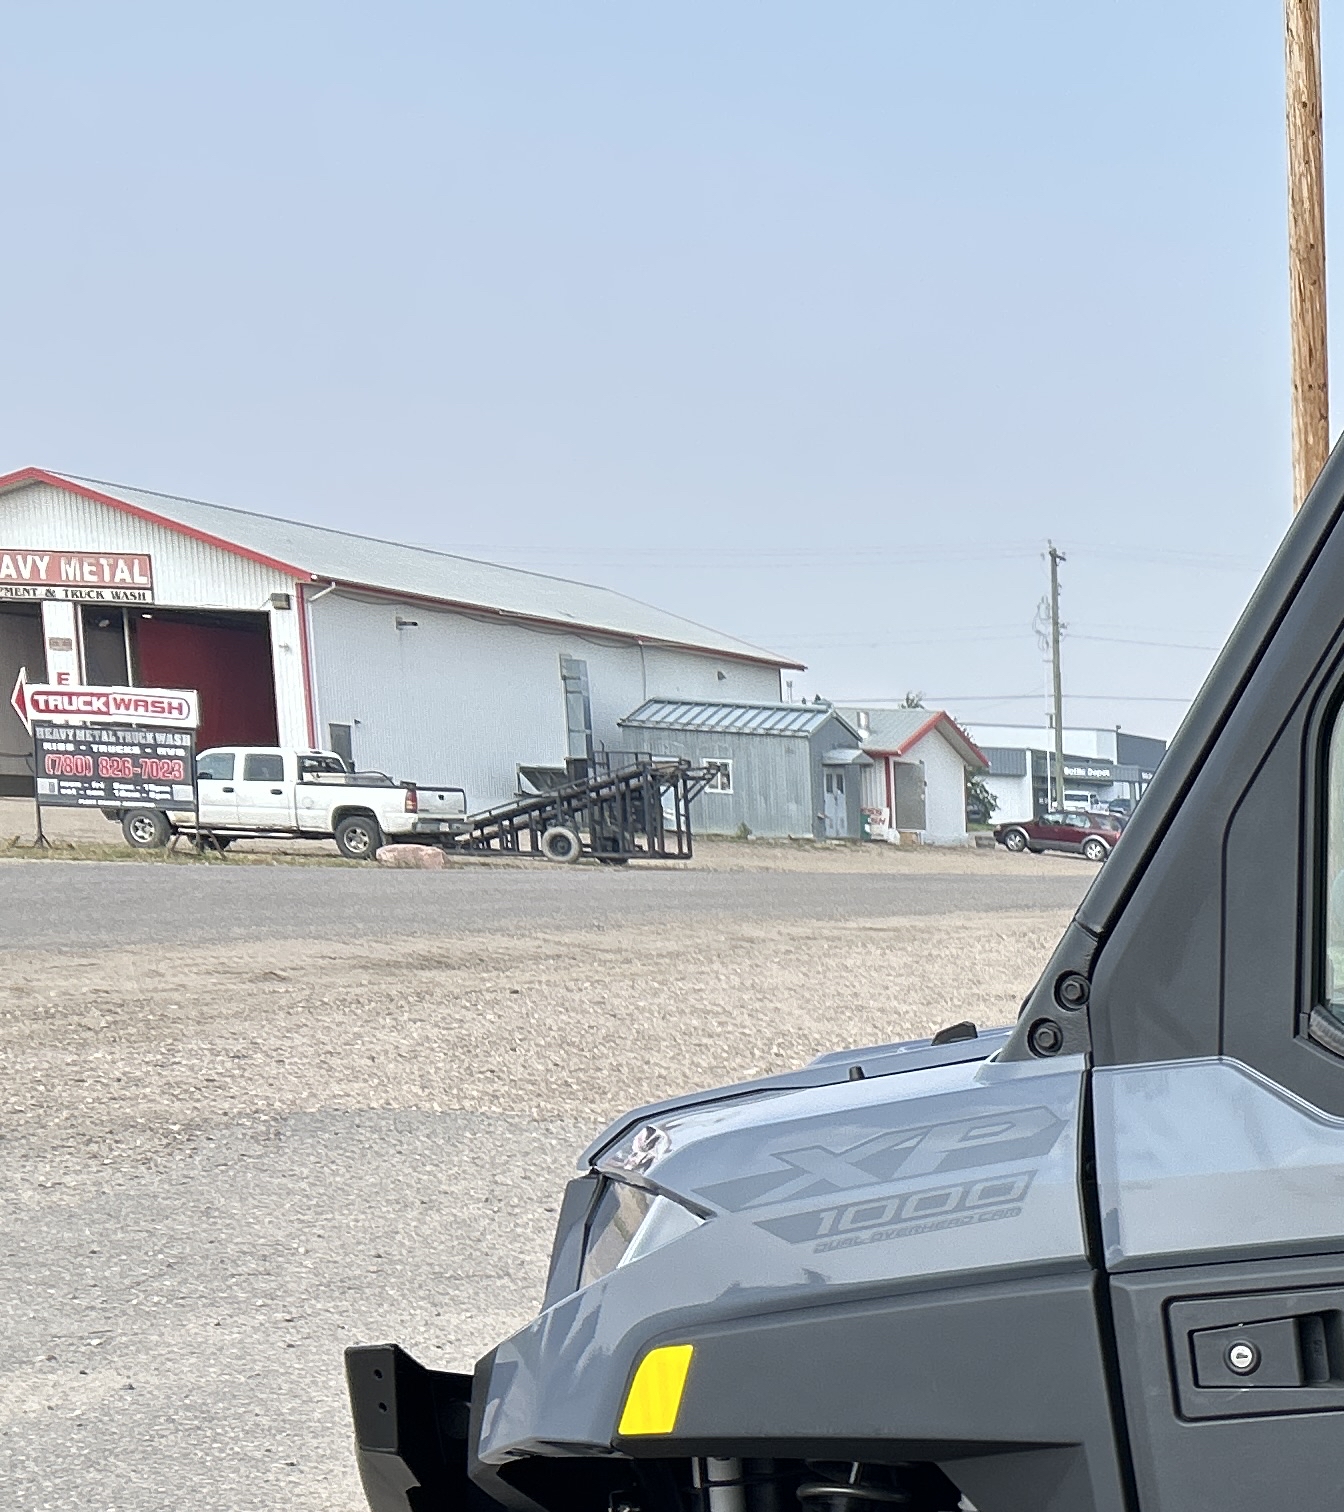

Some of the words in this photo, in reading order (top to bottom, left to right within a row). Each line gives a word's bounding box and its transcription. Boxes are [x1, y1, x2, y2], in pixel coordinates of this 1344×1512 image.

[60, 556, 148, 584] METAL
[62, 589, 105, 600] TRUCK
[111, 590, 147, 601] WASH
[33, 695, 109, 712] TRUCK
[112, 697, 184, 715] WASH
[35, 728, 74, 741] HEAVY
[76, 730, 116, 743] METAL
[118, 732, 154, 745] TRUCK
[155, 733, 191, 746] WASH
[45, 754, 94, 776] (780)
[98, 757, 185, 780] 826-7023
[740, 1105, 1062, 1209] XP
[815, 1174, 1030, 1236] 1000
